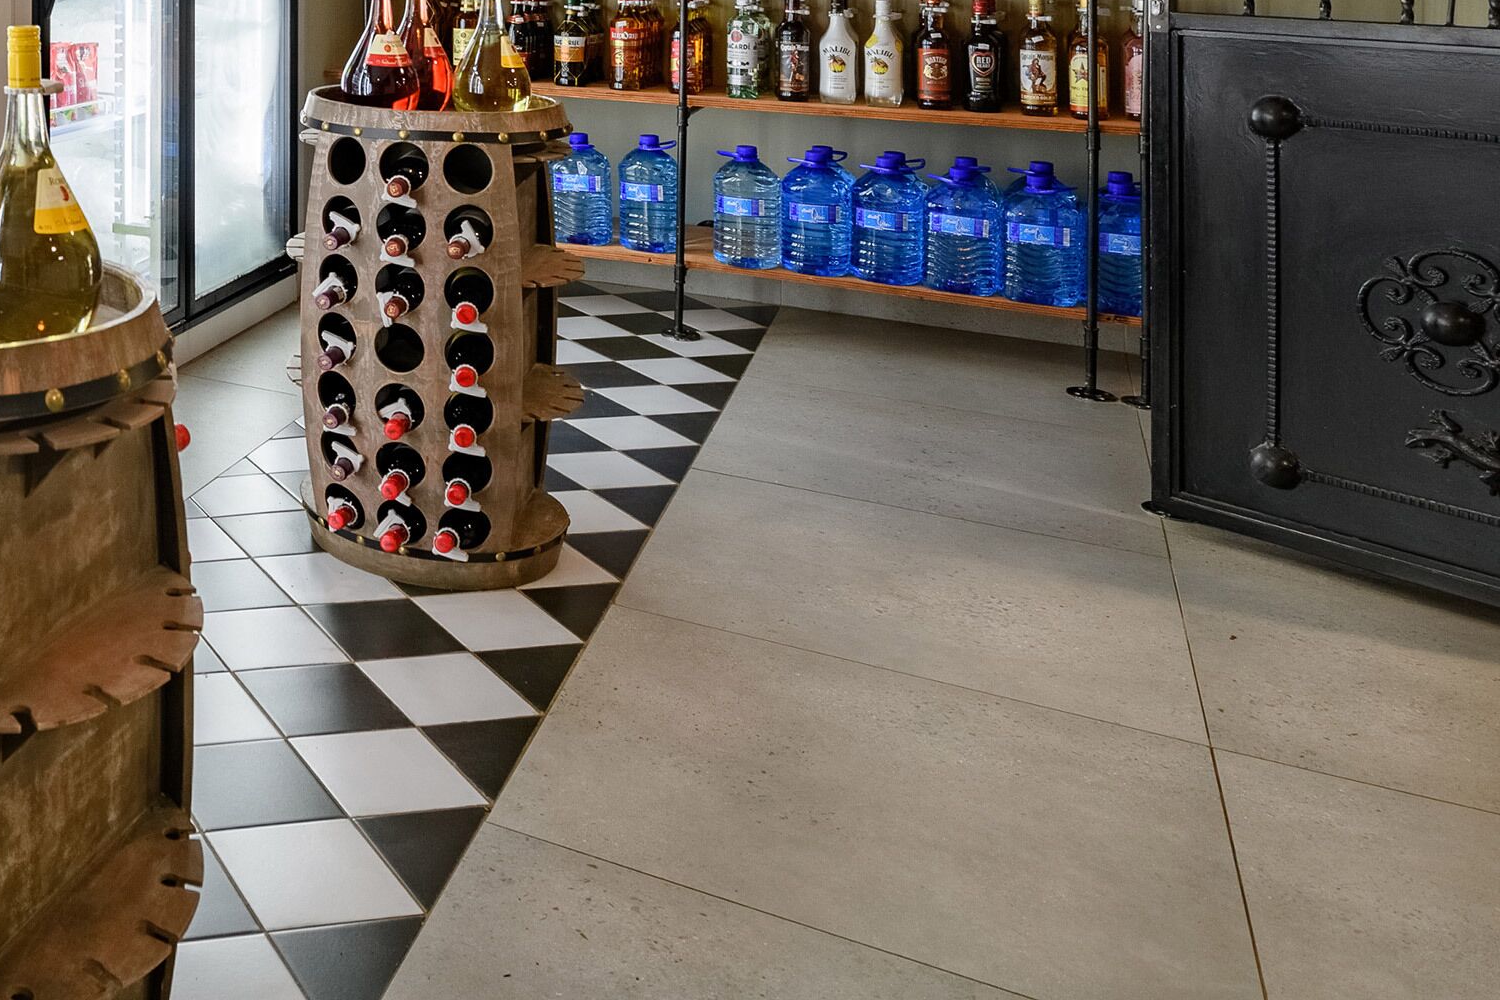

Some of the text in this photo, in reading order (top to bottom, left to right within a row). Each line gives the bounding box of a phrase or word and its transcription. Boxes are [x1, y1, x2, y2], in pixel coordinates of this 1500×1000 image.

[821, 44, 852, 57] MALIBU
[866, 48, 895, 60] MALIBU
[976, 55, 991, 65] RED
